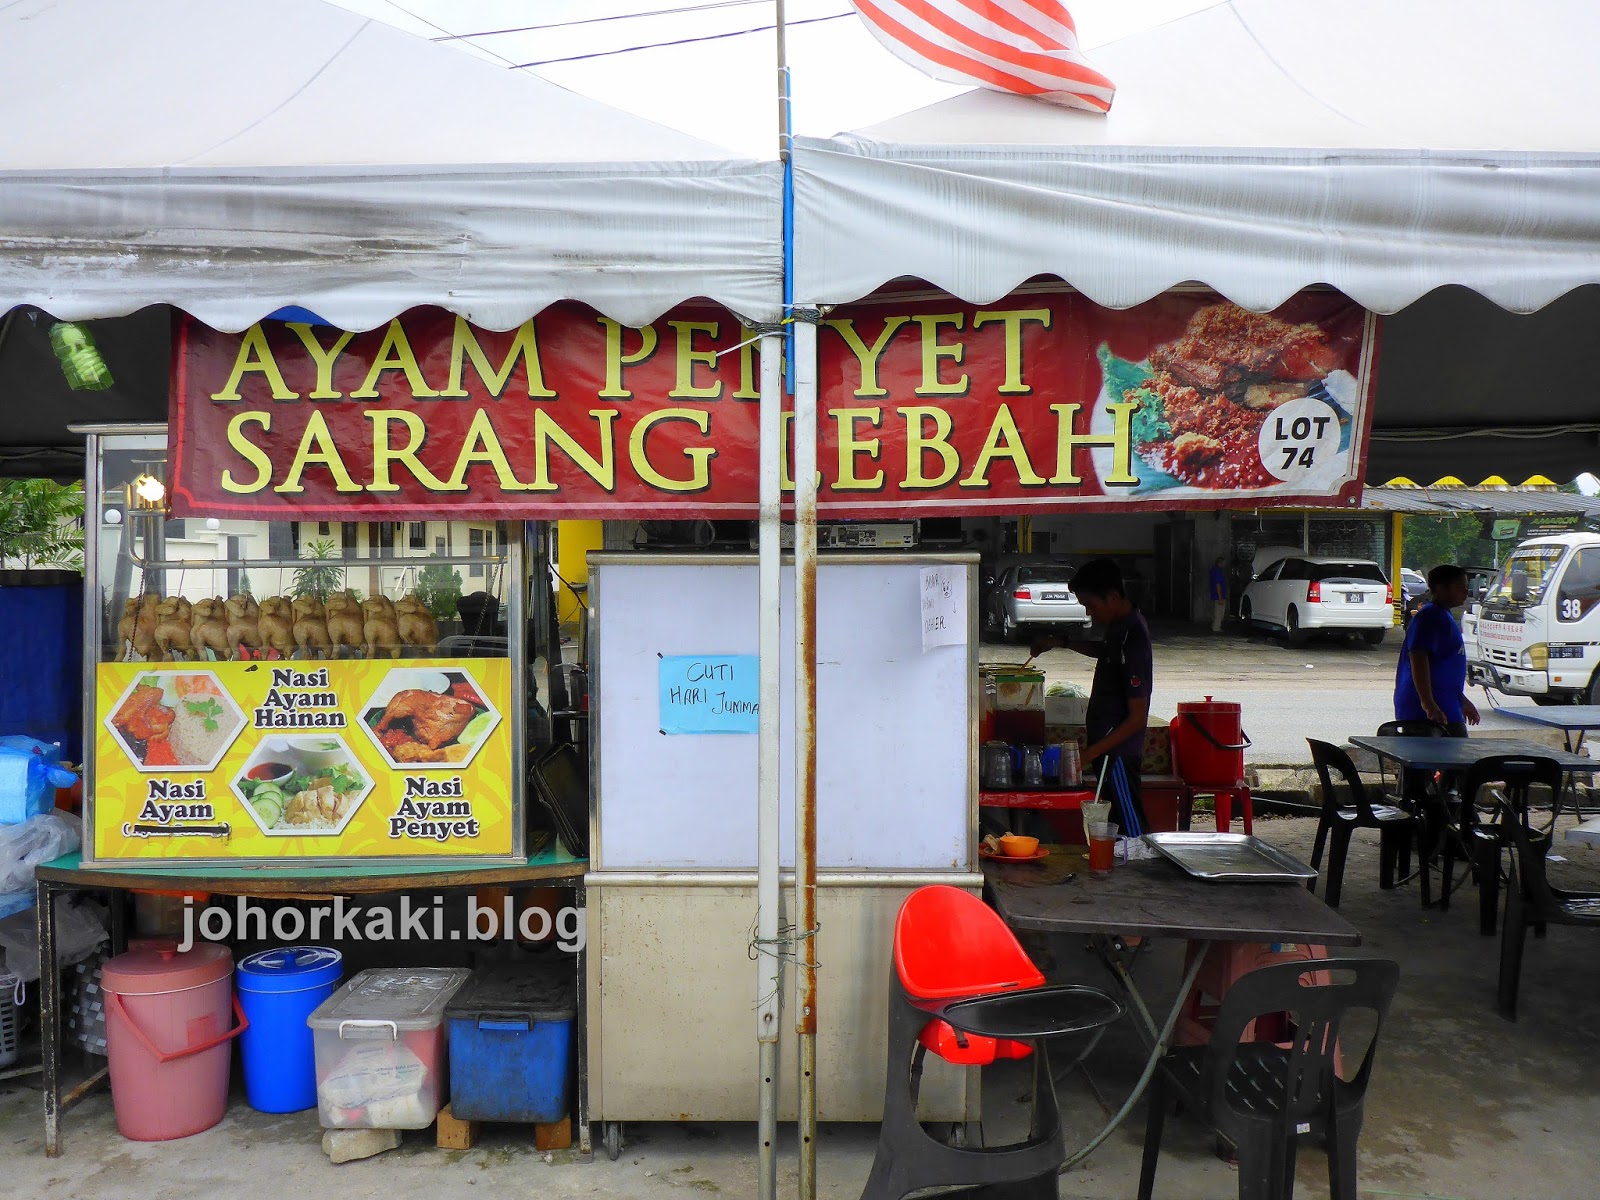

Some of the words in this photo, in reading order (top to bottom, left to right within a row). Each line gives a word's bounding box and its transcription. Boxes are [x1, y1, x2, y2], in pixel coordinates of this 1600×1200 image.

[211, 317, 557, 399] AYAM
[1275, 416, 1331, 440] LOT
[221, 408, 716, 493] SARANG
[781, 402, 1140, 490] LEBAH
[1281, 447, 1315, 470] 74
[1562, 599, 1581, 618] 38
[273, 669, 328, 687] Nasi
[687, 663, 734, 682] CUTI
[265, 689, 336, 708] Ayam
[670, 686, 707, 705] HARI
[255, 709, 346, 727] Hainan
[150, 780, 204, 798] Nasi
[406, 777, 461, 796] Nasi
[140, 801, 213, 821] Ayam
[398, 799, 471, 819] Ayam
[390, 818, 479, 840] Penyet
